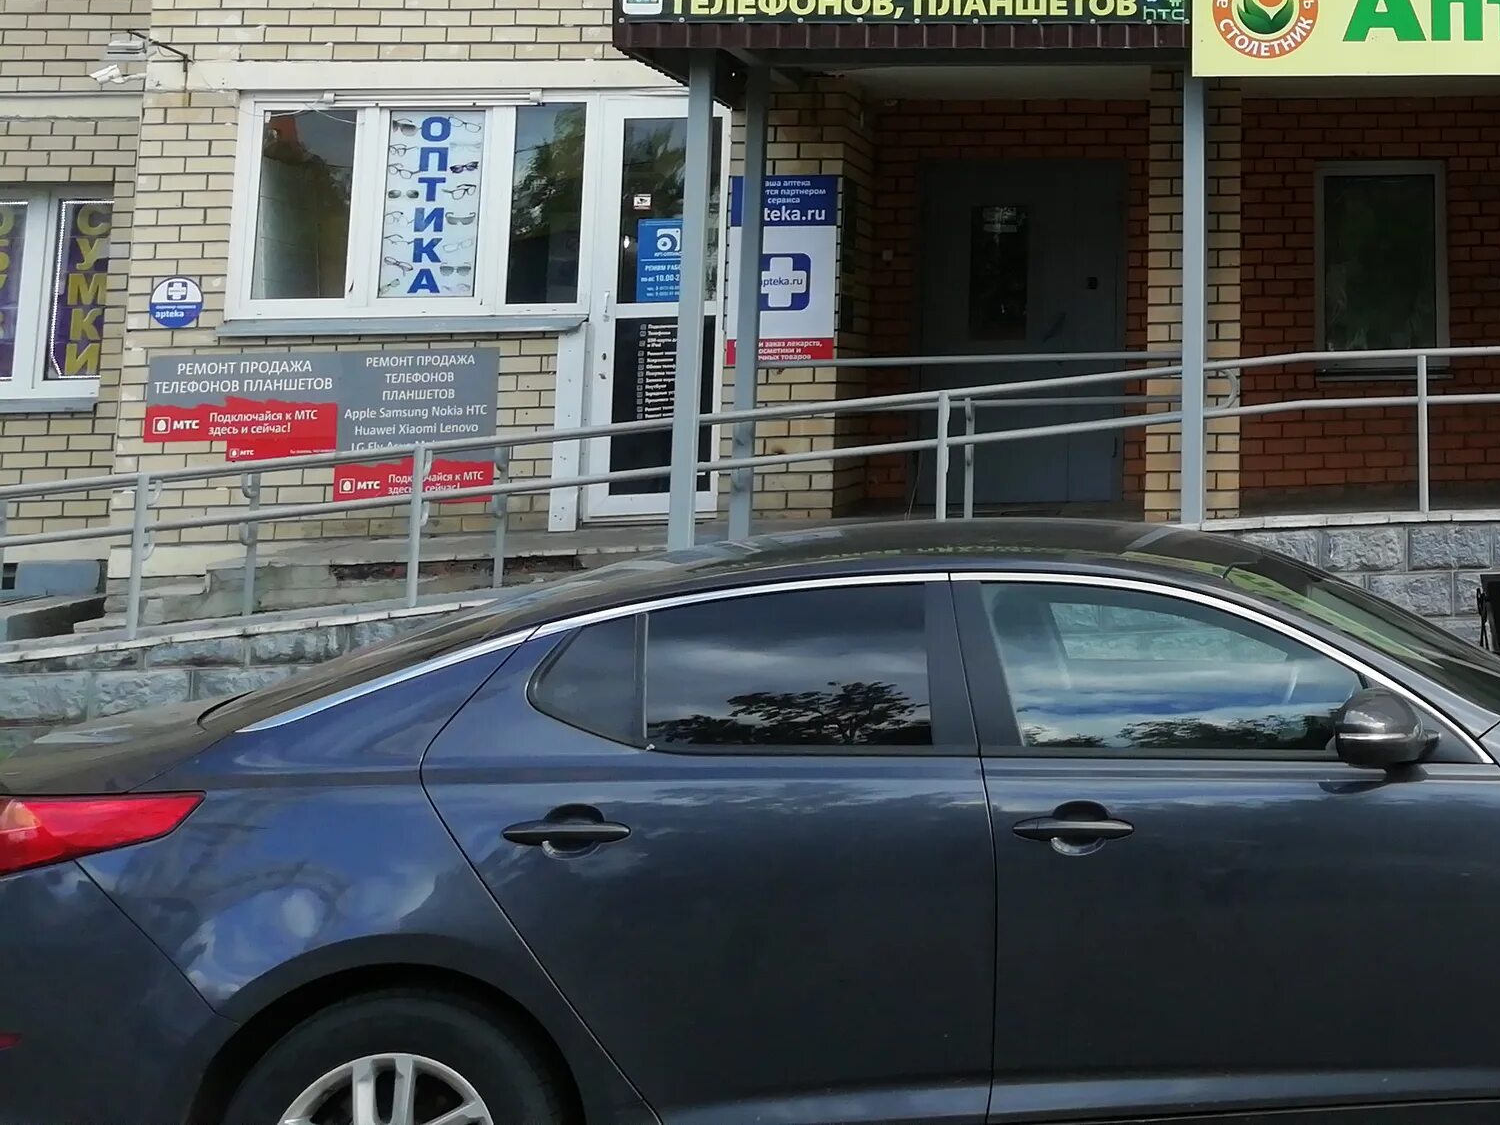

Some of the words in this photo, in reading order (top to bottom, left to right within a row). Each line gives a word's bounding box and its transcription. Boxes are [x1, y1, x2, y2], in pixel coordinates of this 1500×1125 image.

[1219, 16, 1314, 56] СТОЛЕТНИК
[780, 188, 826, 196] партнером
[407, 116, 451, 294] ОПТИКА
[767, 197, 801, 205] сервиса
[763, 205, 826, 221] teka.ru
[64, 204, 112, 375] СУМКИ
[177, 362, 236, 375] РЕМОНТ
[240, 360, 312, 375] ПРОДАЖА
[366, 356, 414, 367] РЕМОНТ
[417, 355, 475, 367] ПРОДАЖА
[385, 372, 454, 383] ТЕЛЕФОНОВ
[154, 380, 239, 394] ТЕЛЕФОНОВ
[243, 378, 333, 392] ПЛАНШЕТОВ
[382, 389, 455, 400] ПЛАНШЕТОВ
[209, 411, 283, 424] Подключайся
[285, 412, 293, 420] к
[294, 410, 318, 420] МТС
[344, 409, 377, 420] Apple
[379, 407, 429, 420] Samsung
[431, 405, 463, 416] Nokia
[466, 405, 488, 415] HTC
[173, 419, 200, 430] МТС
[208, 426, 239, 436] здесь
[251, 422, 291, 434] сейчас!
[354, 425, 396, 436] Huawei
[398, 423, 437, 435] Xiaomi
[439, 423, 479, 433] Lenovo
[388, 472, 453, 484] Подкчайся
[463, 471, 484, 480] МТС
[357, 480, 381, 490] МТС
